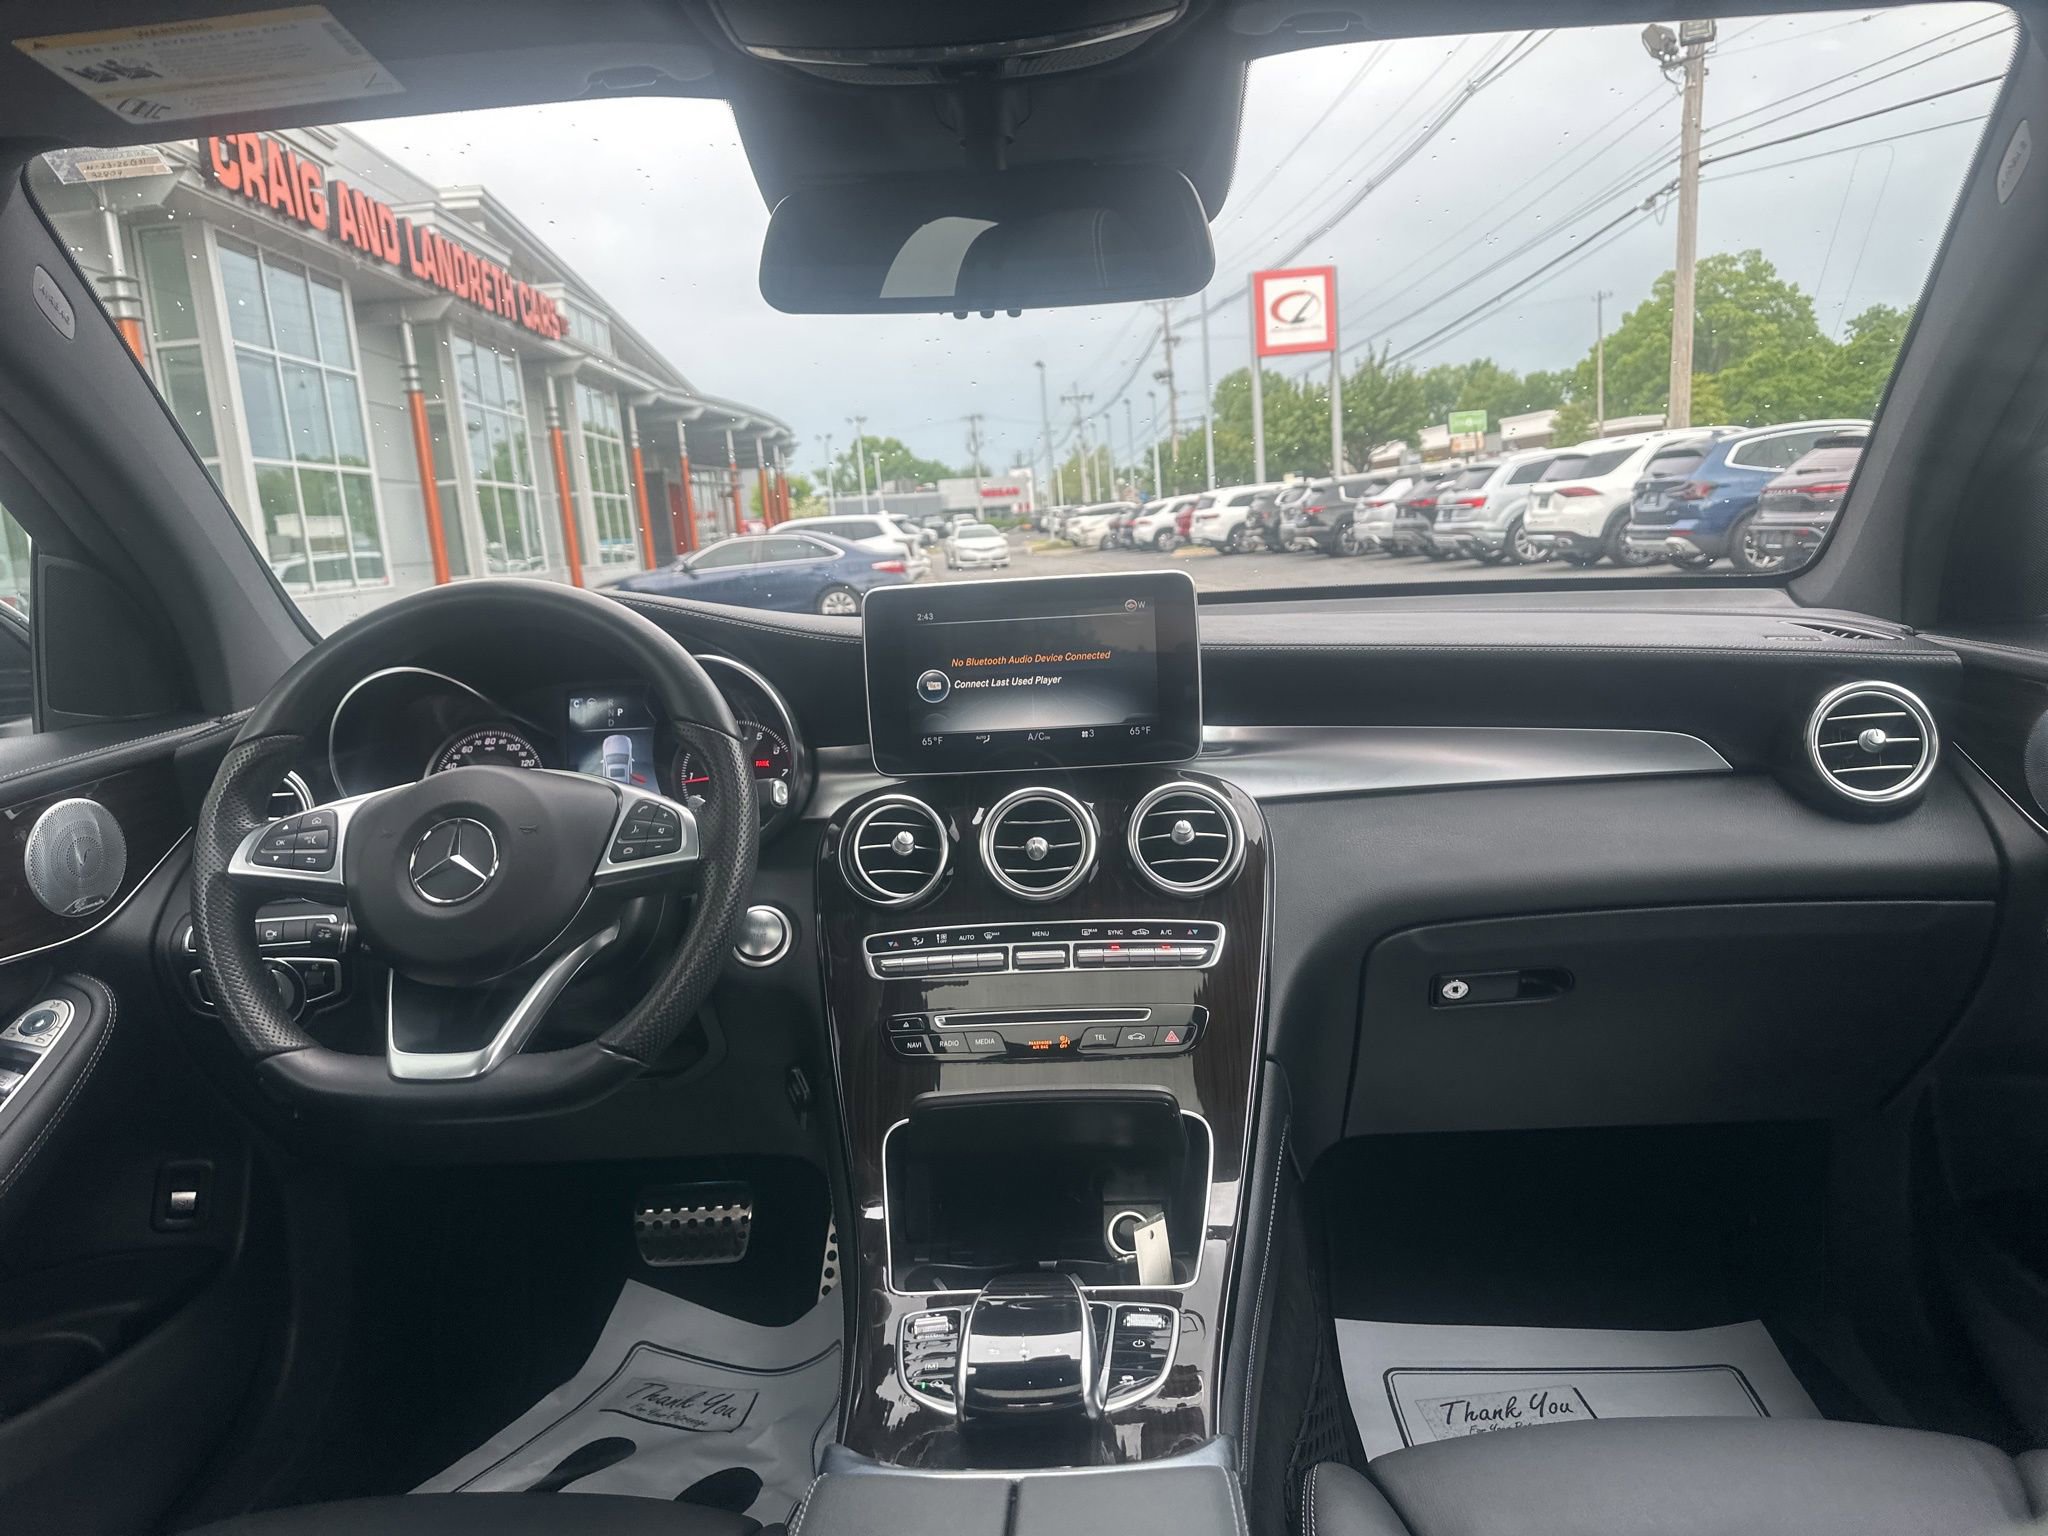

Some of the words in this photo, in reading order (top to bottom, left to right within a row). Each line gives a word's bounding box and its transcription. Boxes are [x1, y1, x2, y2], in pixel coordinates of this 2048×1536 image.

[208, 131, 328, 231] CRAIG
[336, 180, 400, 266] AND
[405, 217, 517, 322] LANDRETH
[518, 281, 561, 341] CARS
[1137, 600, 1146, 609] W
[916, 612, 935, 621] 2:43
[951, 658, 964, 668] No
[965, 656, 1007, 667] Bluetooth
[1008, 655, 1033, 665] Audio
[1034, 653, 1063, 663] Device
[1065, 650, 1112, 661] Connected
[954, 678, 989, 689] Connect
[991, 677, 1010, 688] Last
[1011, 676, 1034, 686] Used
[1034, 675, 1062, 687] Player
[617, 707, 624, 717] P
[607, 718, 615, 728] D
[756, 732, 763, 741] 5
[484, 737, 497, 746] 80
[461, 745, 474, 754] 60
[506, 743, 521, 752] 100
[444, 762, 458, 771] 40
[520, 759, 535, 768] 120
[781, 768, 789, 777] 7
[939, 1040, 960, 1048] RADIO
[626, 1382, 708, 1409] Thank
[700, 1393, 738, 1419] You
[1440, 1396, 1522, 1425] Thank
[1529, 1391, 1574, 1418] You
